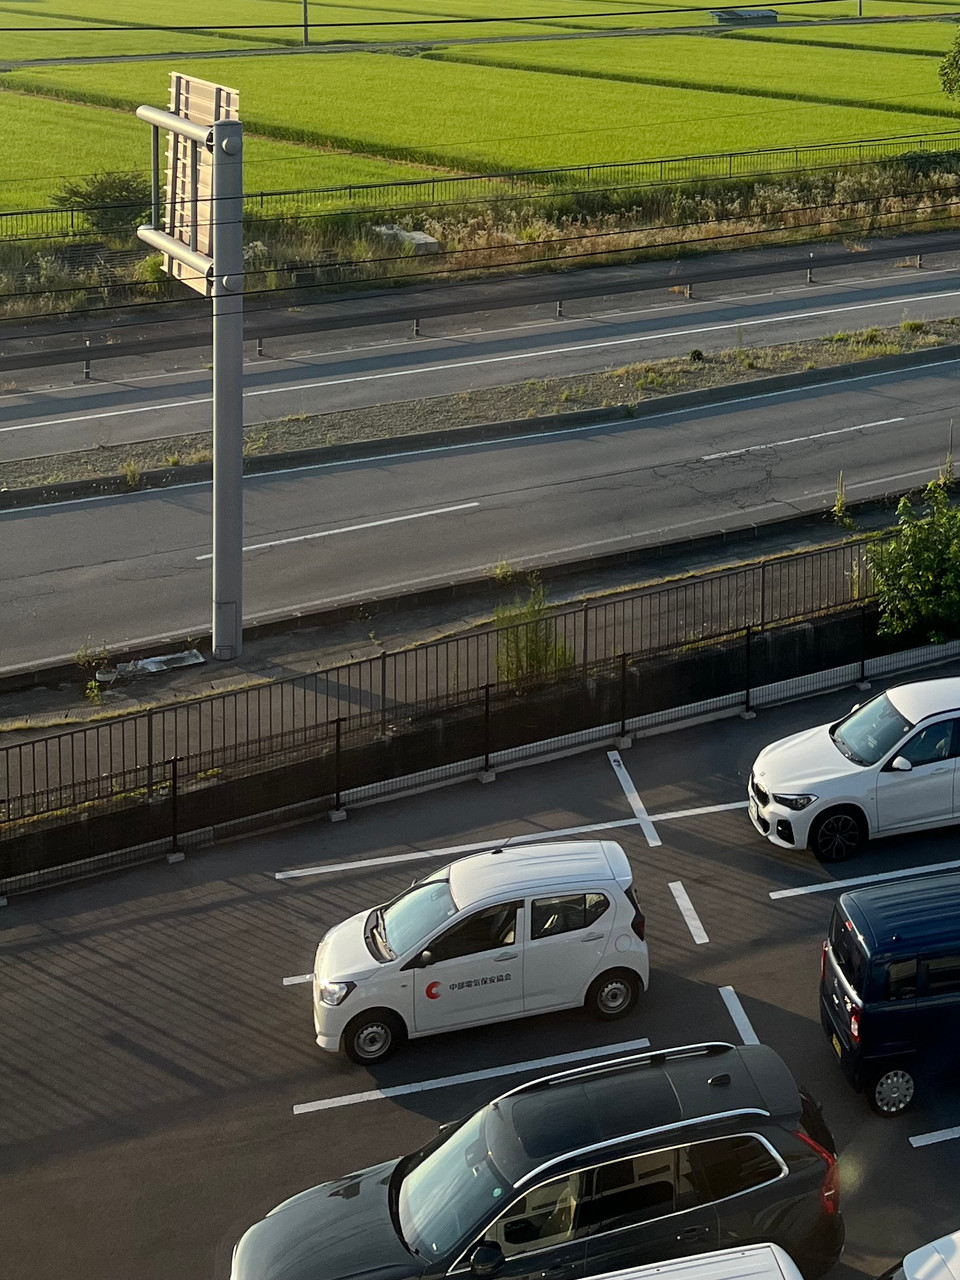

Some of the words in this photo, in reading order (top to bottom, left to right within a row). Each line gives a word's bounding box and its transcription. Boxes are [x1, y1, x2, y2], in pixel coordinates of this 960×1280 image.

[449, 973, 511, 990] 中部電気保安協会
